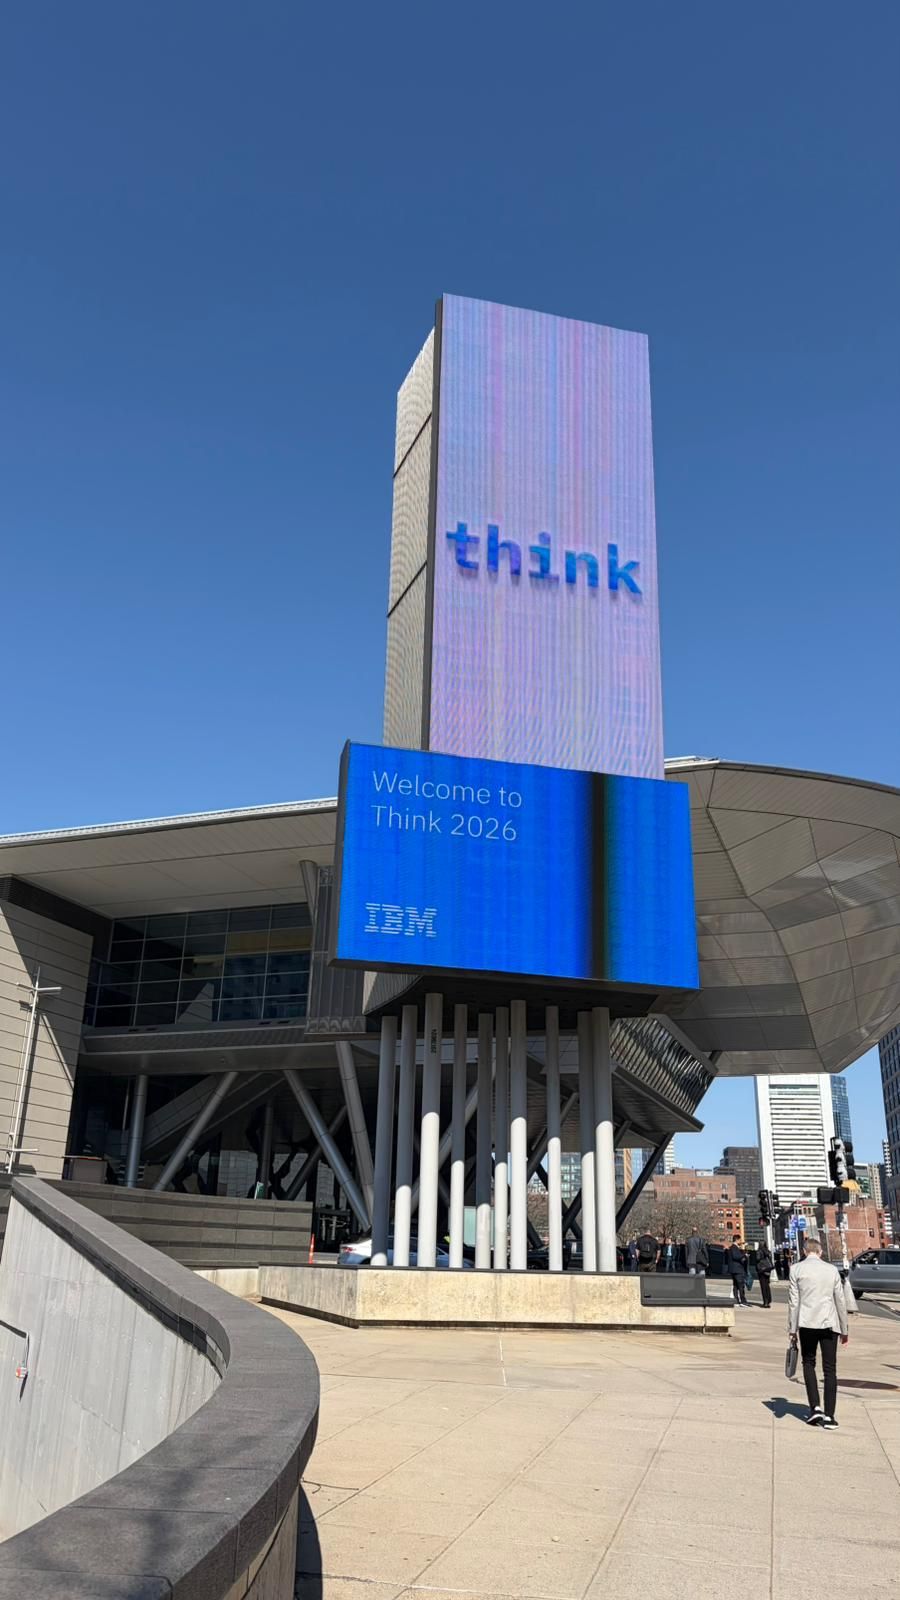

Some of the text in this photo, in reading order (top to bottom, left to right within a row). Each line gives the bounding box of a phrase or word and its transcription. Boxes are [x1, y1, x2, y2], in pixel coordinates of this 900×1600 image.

[446, 521, 642, 595] think
[372, 770, 522, 808] Welcome to
[370, 804, 517, 841] Think 2026
[364, 903, 437, 937] IBM
